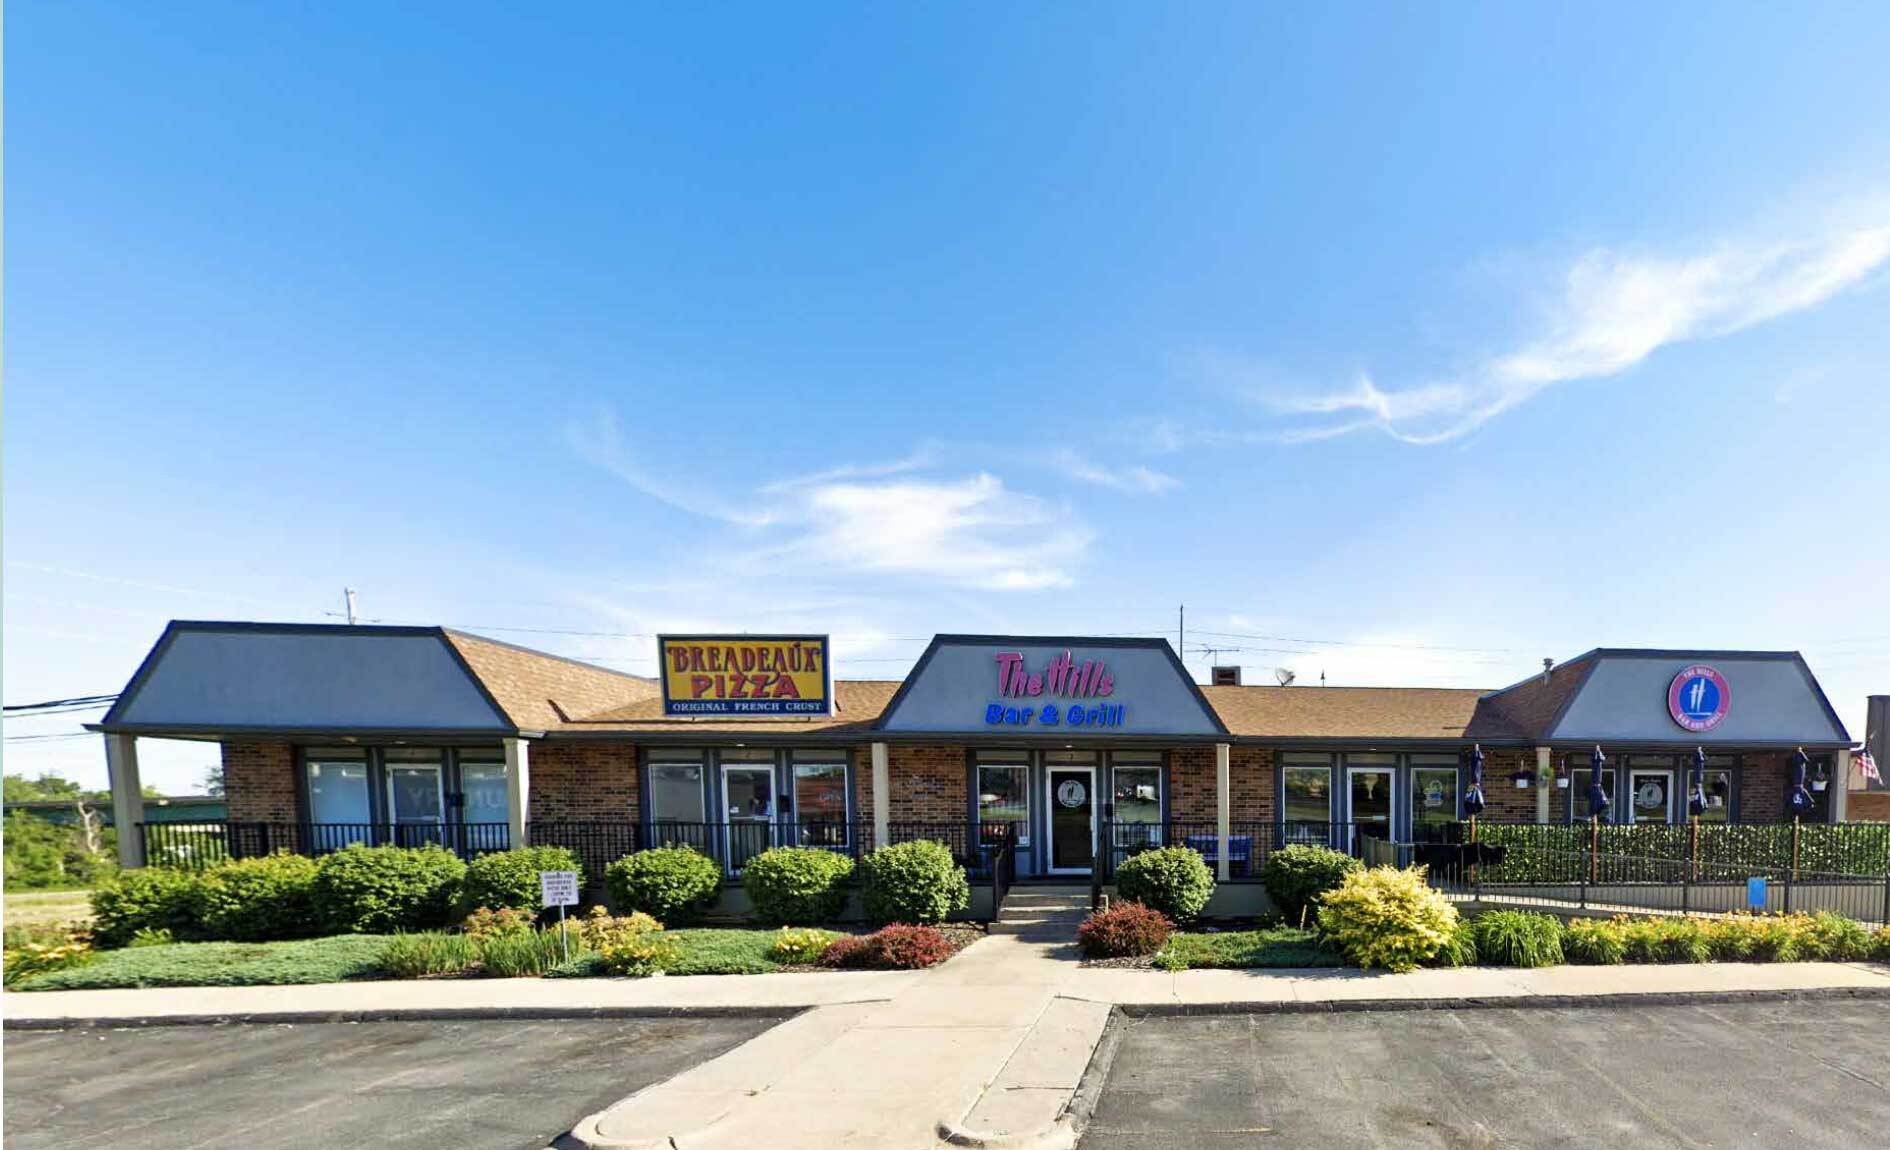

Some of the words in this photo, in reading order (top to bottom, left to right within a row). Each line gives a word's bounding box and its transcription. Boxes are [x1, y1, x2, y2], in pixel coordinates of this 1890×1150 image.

[995, 651, 1043, 698] The
[1046, 649, 1114, 698] Hills
[690, 674, 800, 699] PIZZA
[673, 702, 728, 712] ORIGINAL
[735, 702, 780, 711] FRENCH
[785, 702, 822, 711] CRUST
[984, 704, 1034, 725] Bar
[1038, 704, 1060, 725] &
[1066, 702, 1126, 726] Grill
